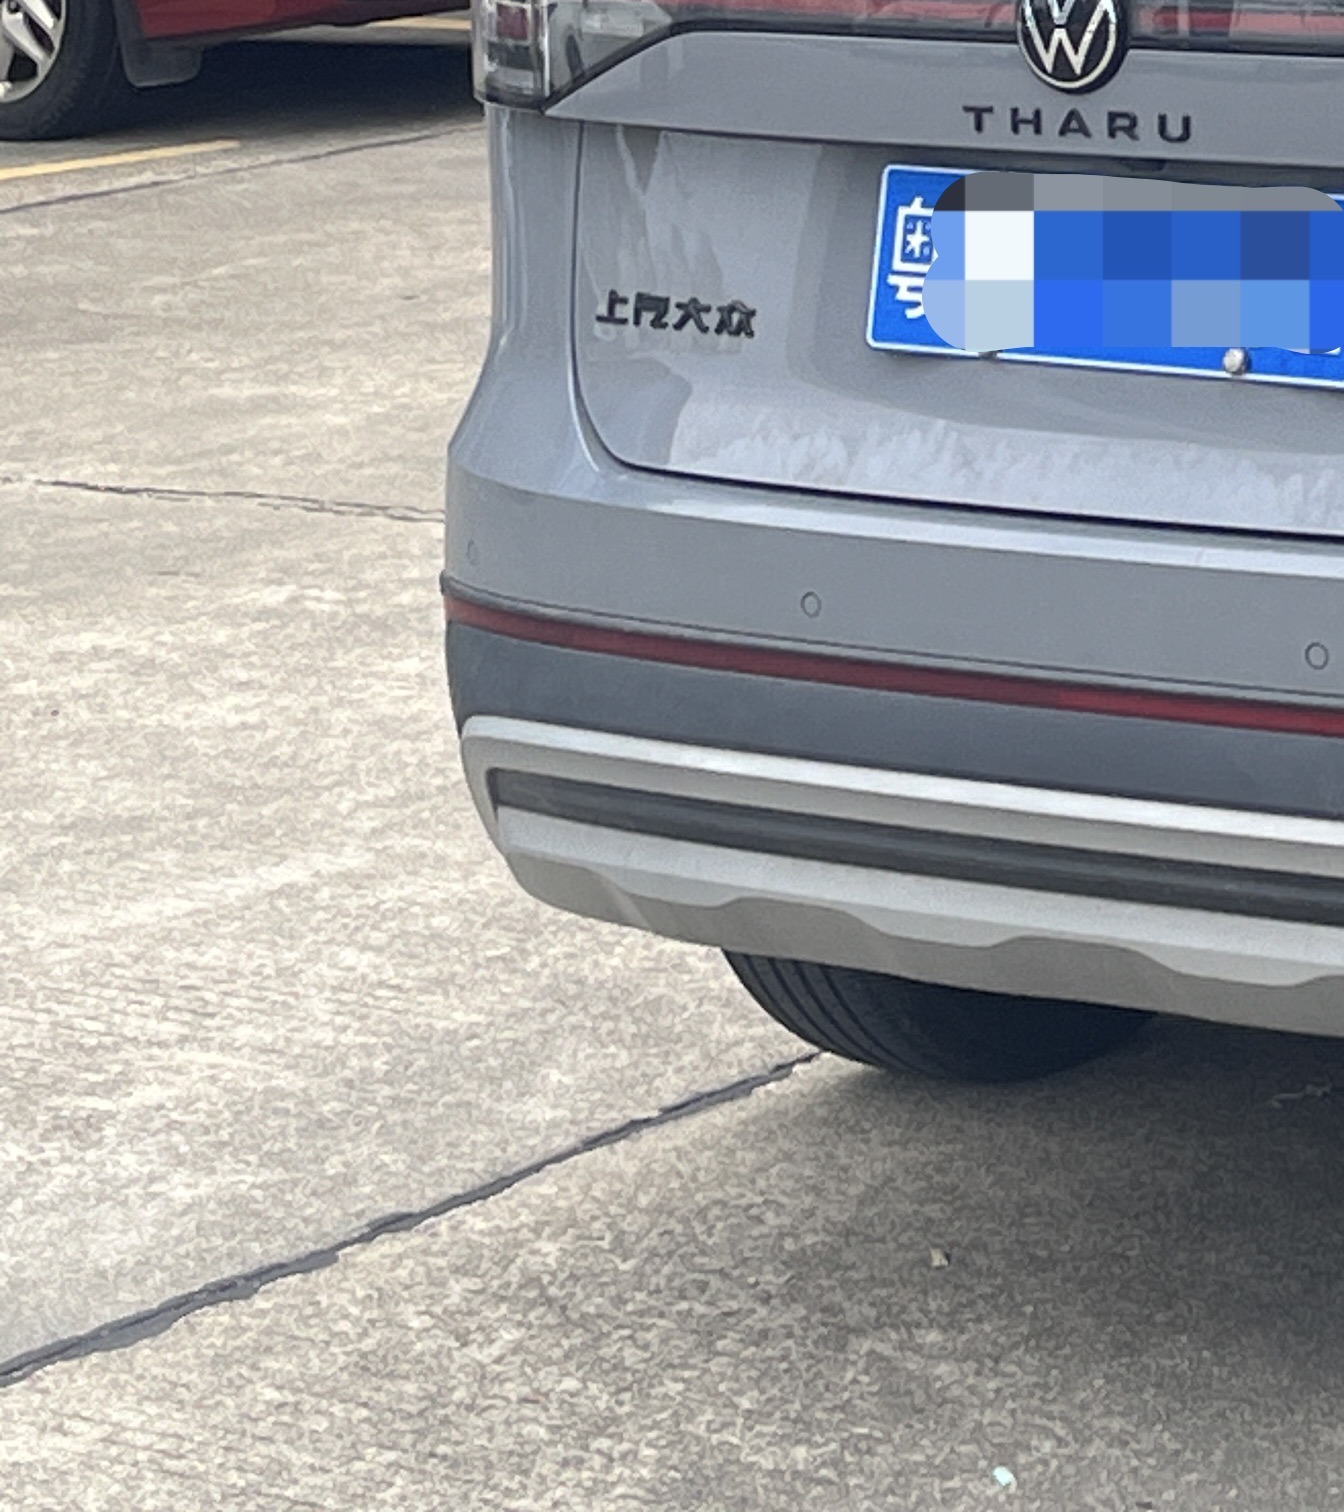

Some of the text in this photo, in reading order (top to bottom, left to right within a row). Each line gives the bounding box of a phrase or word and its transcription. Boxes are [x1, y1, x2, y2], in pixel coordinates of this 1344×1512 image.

[962, 105, 1191, 143] THARU
[595, 289, 757, 338] 上汽大众
